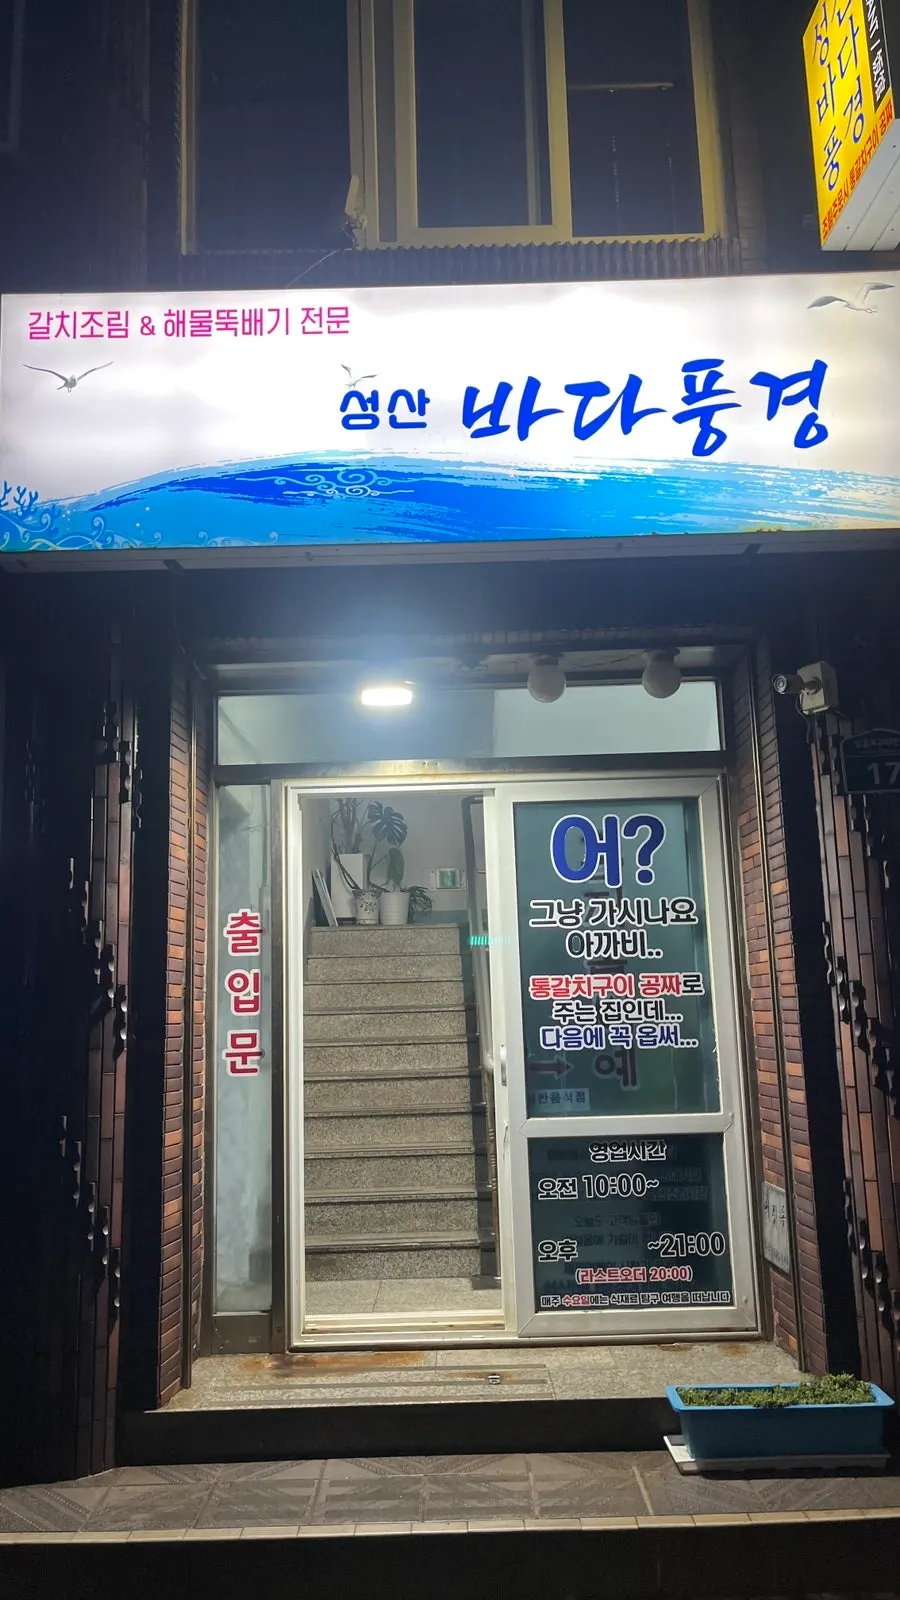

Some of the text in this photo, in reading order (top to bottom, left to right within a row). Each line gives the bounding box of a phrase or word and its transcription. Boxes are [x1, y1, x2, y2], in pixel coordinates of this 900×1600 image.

[28, 306, 351, 340] 갈치조림 & 해물뚝배기 전문
[339, 388, 430, 431] 성산
[550, 813, 667, 889] 어?
[529, 896, 699, 929] 그냥 가시나요
[565, 929, 664, 960] 아까비..
[223, 908, 264, 1076] 출입문
[529, 972, 704, 1000] 통갈치구이 공짜로
[552, 998, 683, 1024] 주는 집인데...
[539, 1026, 604, 1050] 다음에
[608, 1025, 633, 1048] 꼭
[588, 1139, 668, 1163] 영업시간
[537, 1177, 579, 1200] 오전
[582, 1172, 660, 1199] 10:00~
[537, 1238, 579, 1262] 오후
[647, 1231, 726, 1258] ~21:00
[574, 1267, 647, 1284] (라스트오더
[649, 1265, 693, 1283] 20:00)
[541, 1295, 562, 1308] 매주
[562, 1294, 609, 1307] 수요일에는
[661, 1292, 690, 1305] 여행을
[691, 1290, 731, 1304] 떠납니다
